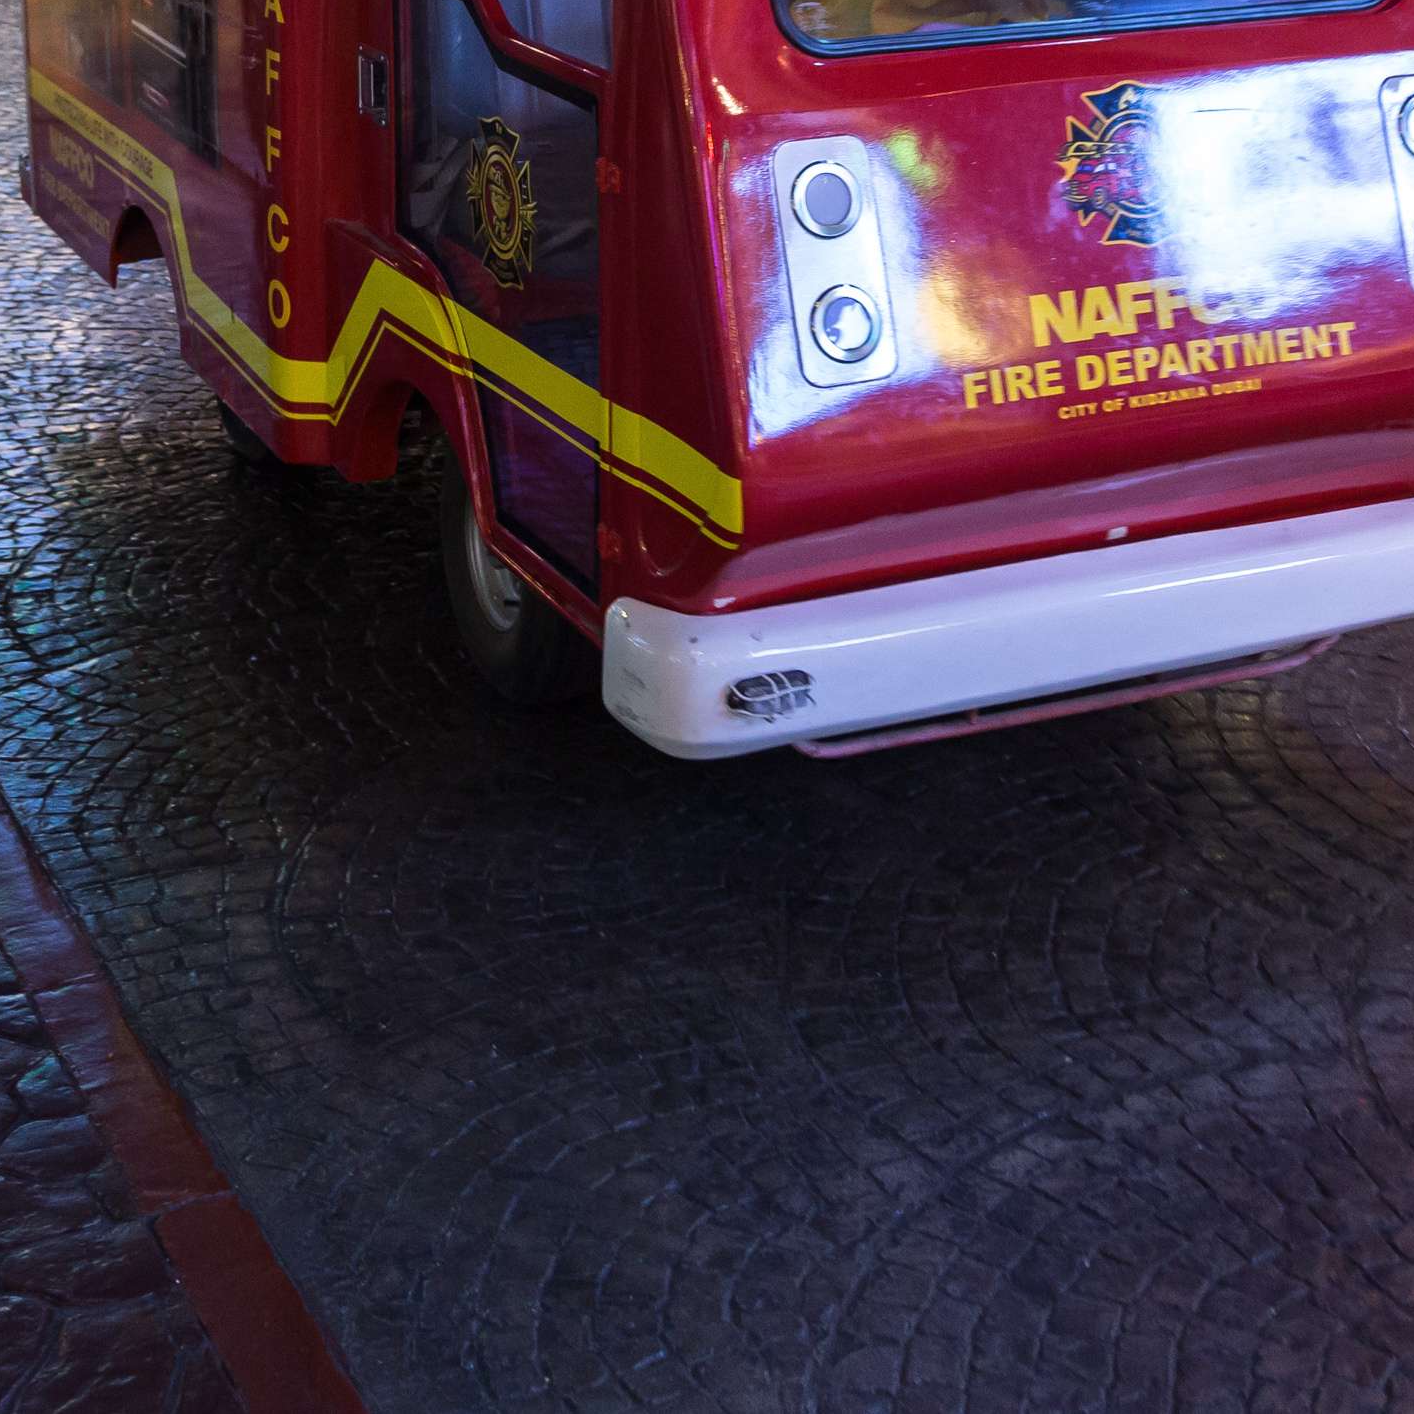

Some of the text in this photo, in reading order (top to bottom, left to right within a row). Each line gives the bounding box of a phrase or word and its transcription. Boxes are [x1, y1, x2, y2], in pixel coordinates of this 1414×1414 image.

[962, 321, 1357, 410] FIRE DEPARTMENT
[1057, 377, 1263, 420] CITY OF KIDZANIA DUBAI
